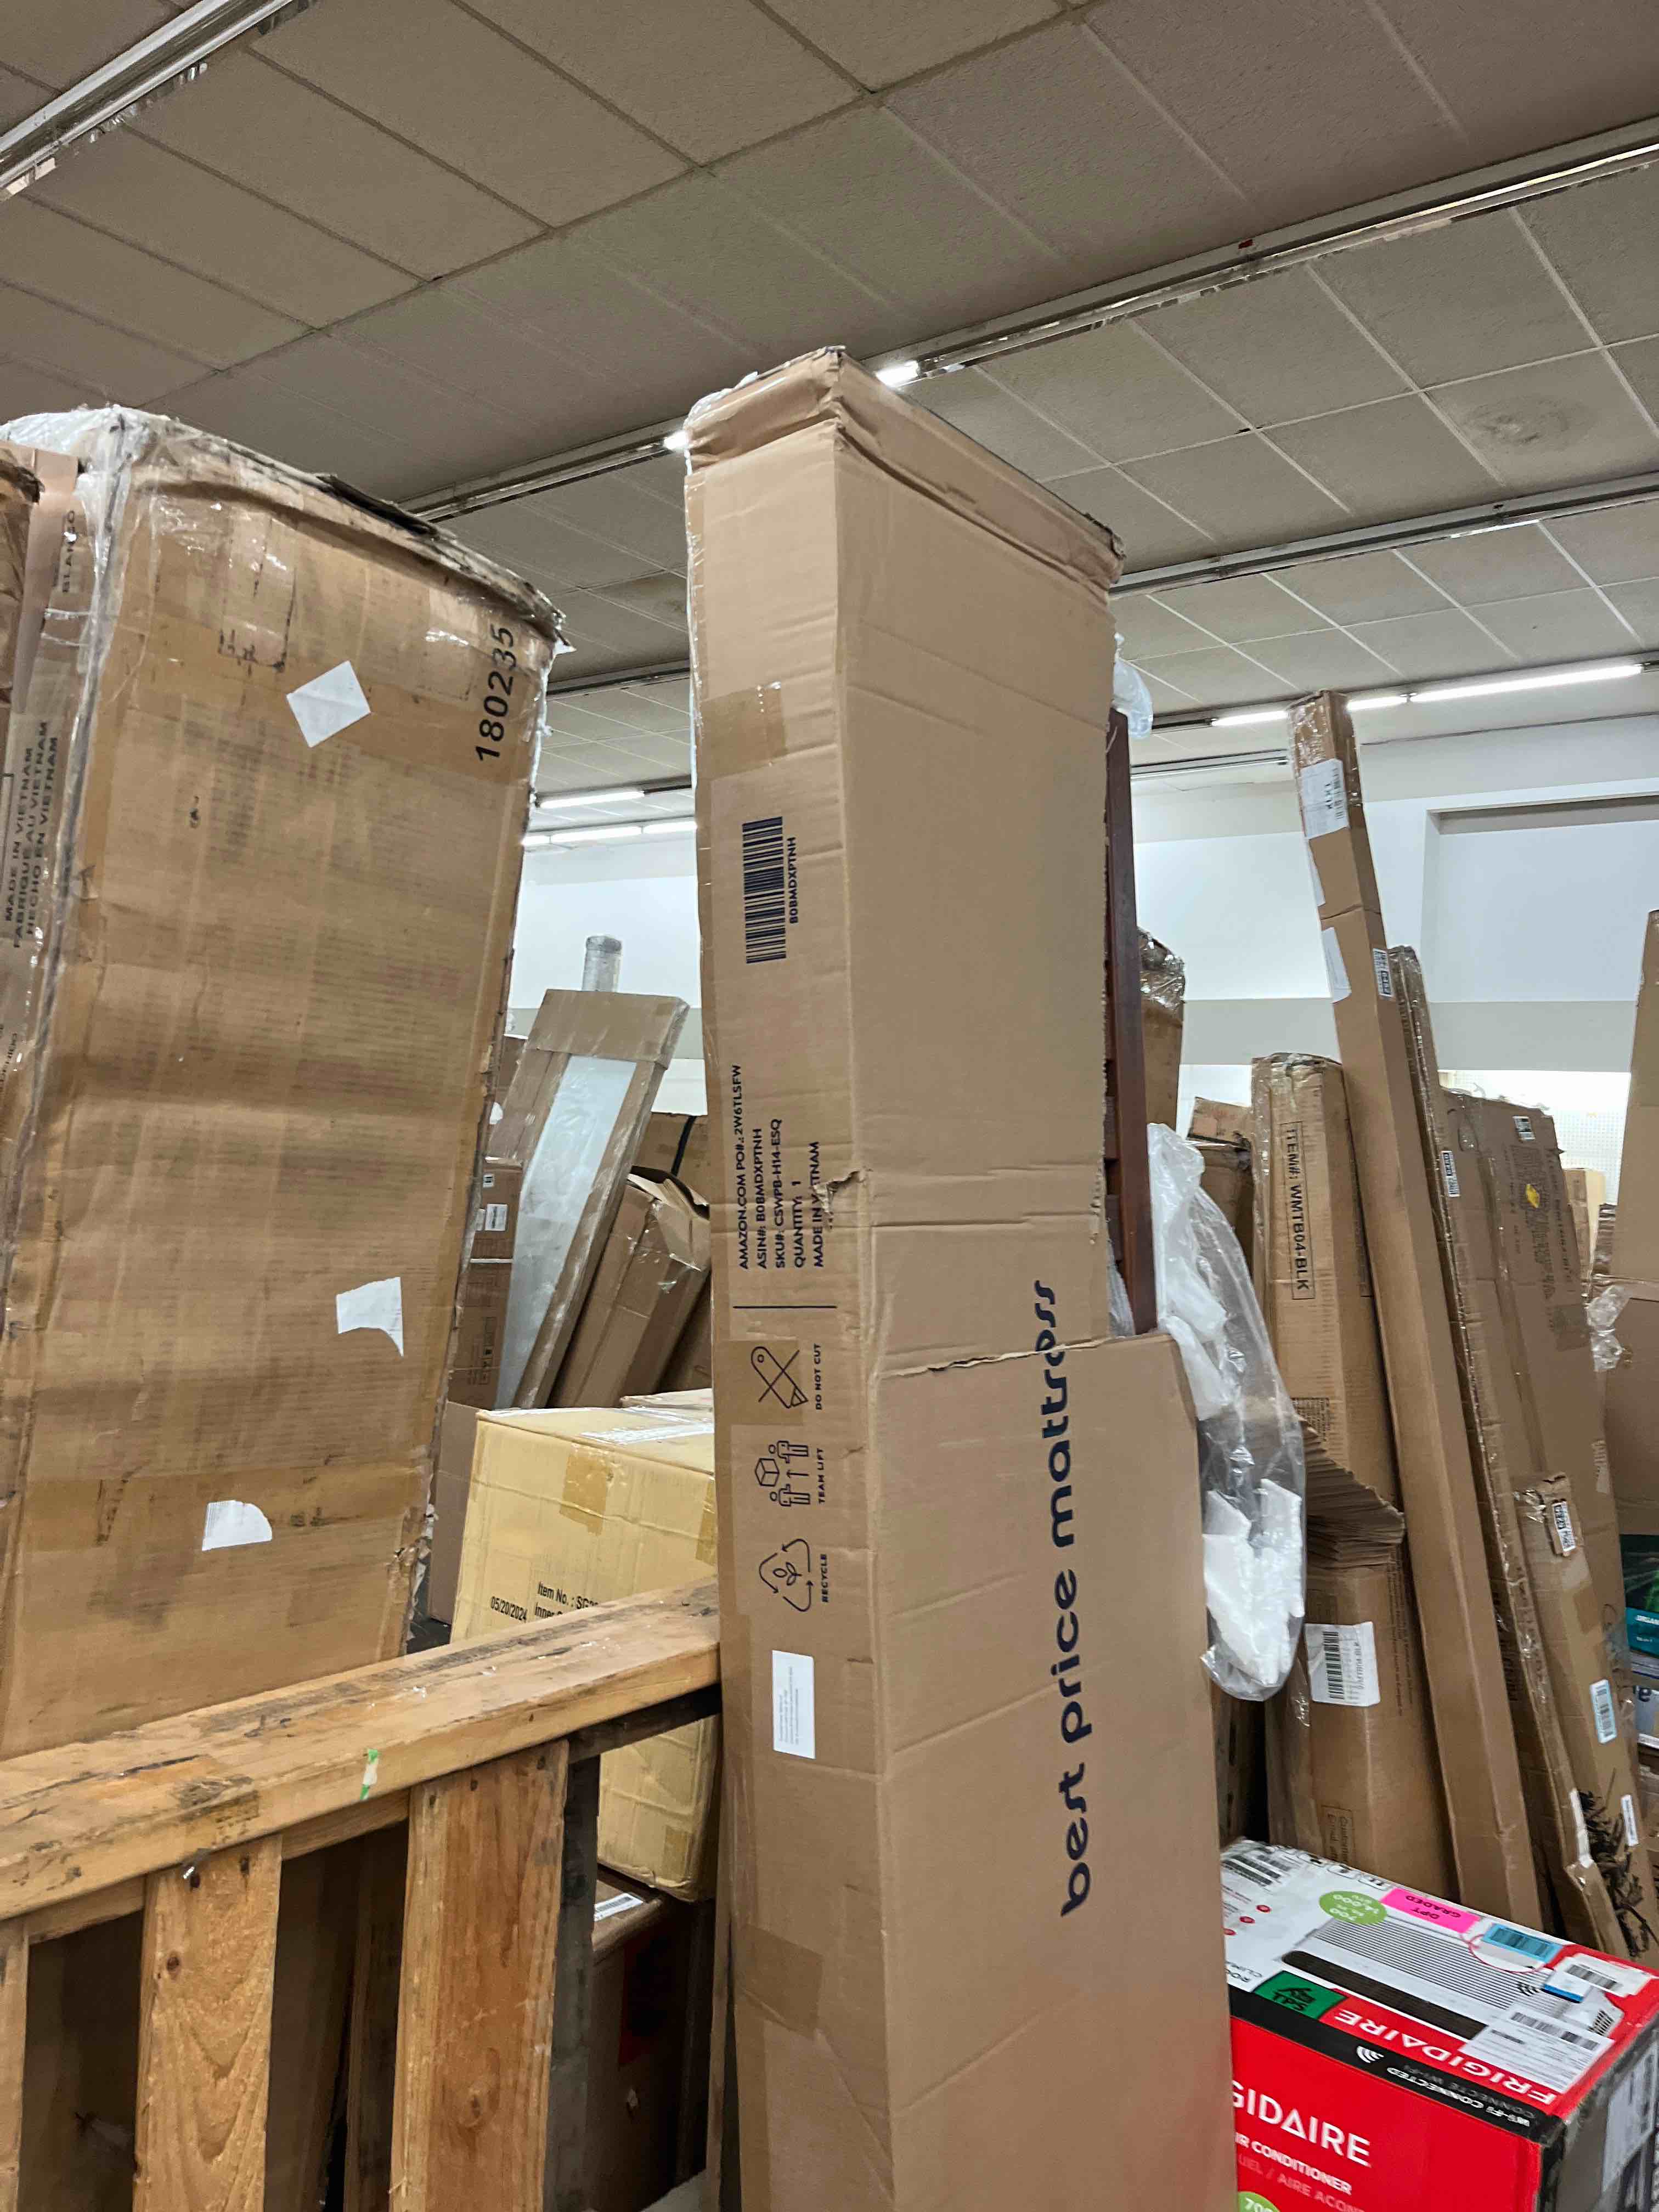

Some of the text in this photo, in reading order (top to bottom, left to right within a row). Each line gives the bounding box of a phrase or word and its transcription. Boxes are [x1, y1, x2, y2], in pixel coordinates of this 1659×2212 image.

[475, 624, 517, 762] 180235
[5, 748, 33, 922] MADE IN VIETNAM
[13, 722, 48, 948] FABRIQUE AU VIETNAM
[26, 737, 58, 935] HECHO EN VIETNAM
[737, 1173, 749, 1270] AMAZON.COM
[812, 1207, 822, 1222] IN
[1286, 1128, 1310, 1290] ITEM#: WMTB04-BLK
[756, 1226, 768, 1270] ASIN#:
[811, 1226, 823, 1268] MADE
[813, 1342, 821, 1365] CUT
[815, 1394, 822, 1410] DO
[816, 1448, 825, 1471] LIFT
[537, 1580, 555, 1600] Item
[820, 1553, 829, 1603] RECYCLE
[1034, 1279, 1093, 1918] best price mattress
[490, 1595, 528, 1623] 05/20/2024
[1334, 2008, 1557, 2106] FRIGIDAIRE
[1386, 2067, 1484, 2109] CONNECTED
[1251, 2140, 1353, 2196] CONDITIONER
[1277, 2172, 1313, 2197] AIRE
